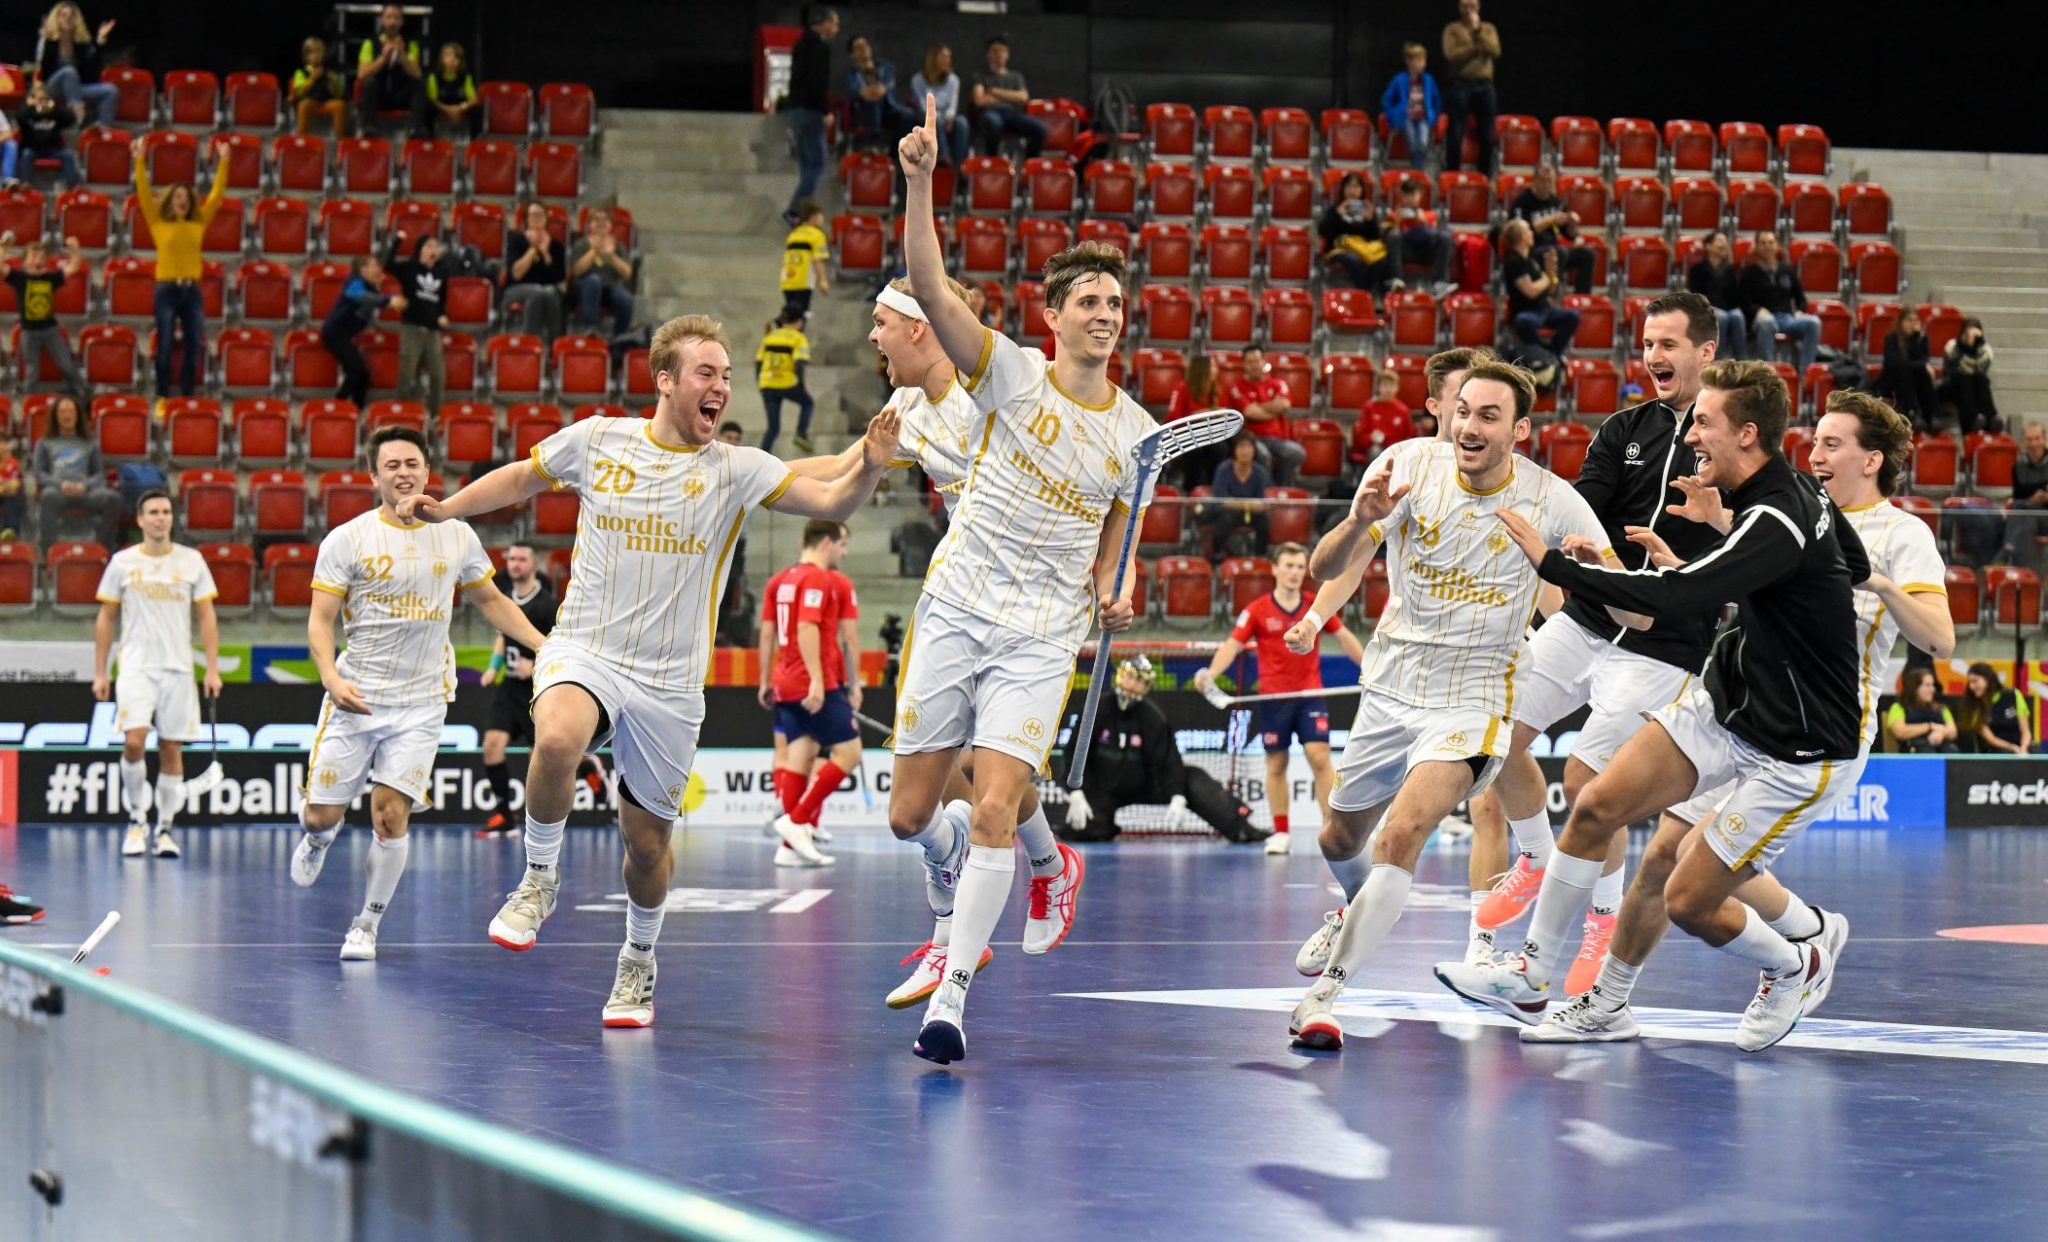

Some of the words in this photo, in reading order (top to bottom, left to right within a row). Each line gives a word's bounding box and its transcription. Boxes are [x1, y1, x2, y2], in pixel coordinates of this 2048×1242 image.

[1026, 404, 1061, 446] 10
[592, 458, 637, 495] 20
[595, 512, 679, 538] nordic
[625, 532, 707, 555] minds
[361, 554, 394, 581] 32
[389, 605, 445, 622] minds
